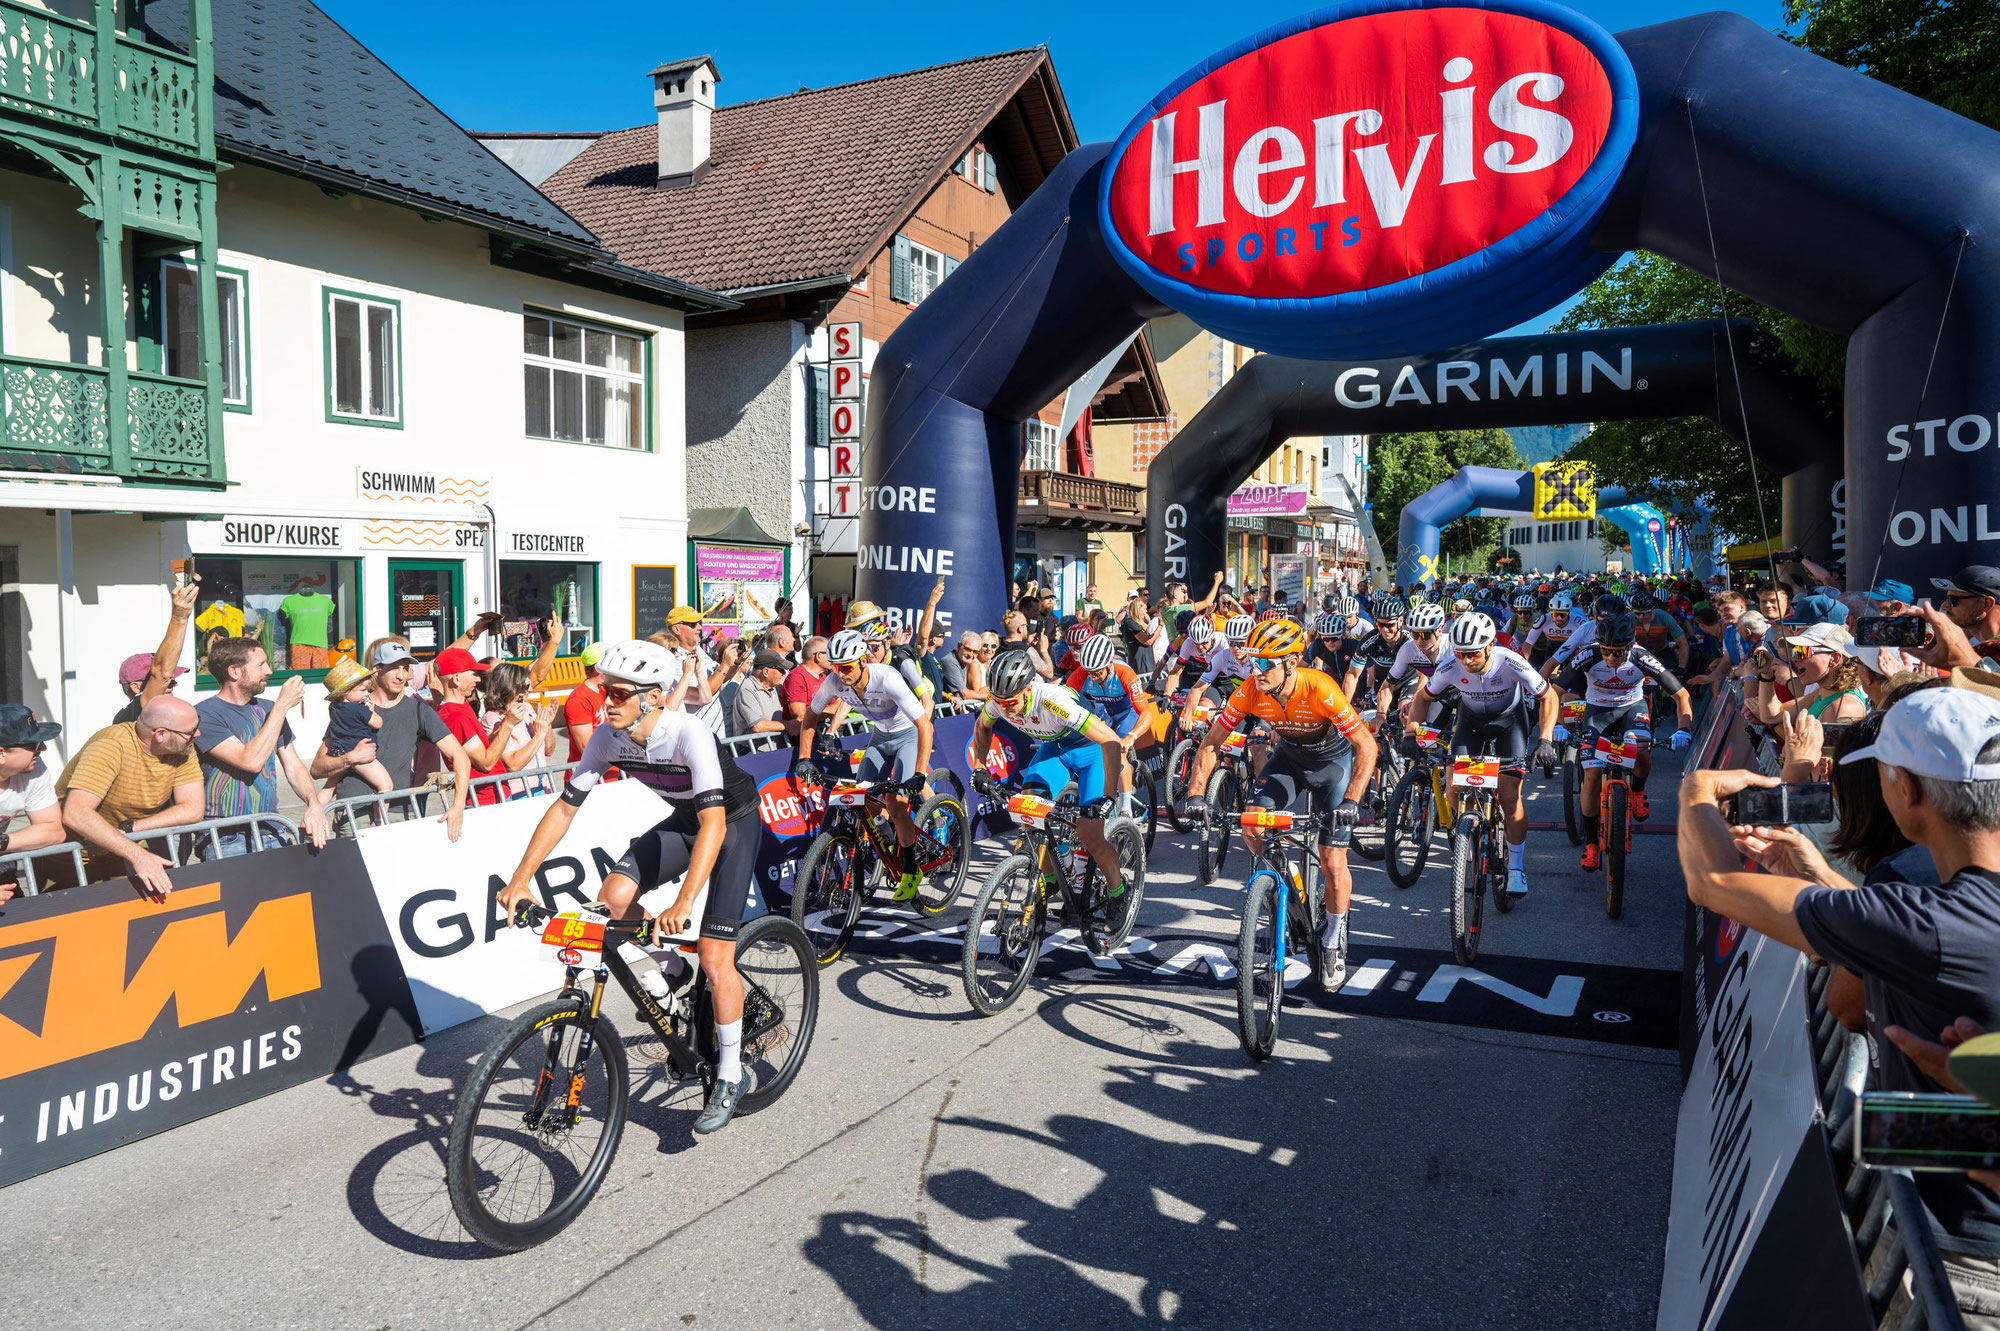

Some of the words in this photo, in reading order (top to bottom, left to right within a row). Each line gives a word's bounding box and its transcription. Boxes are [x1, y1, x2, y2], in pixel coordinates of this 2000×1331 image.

[1147, 57, 1574, 237] Hervis
[1177, 216, 1361, 272] SPORTS
[1334, 347, 1632, 409] GARMIN
[834, 326, 853, 514] SPORT
[1886, 412, 2000, 462] STO
[361, 471, 436, 494] SCHWIMM
[860, 485, 936, 514] STORE
[1240, 485, 1288, 504] ZOPF
[224, 521, 341, 546] SHOP/KURSE
[511, 533, 584, 553] TESTCENTER
[1164, 503, 1188, 587] GAR
[703, 560, 726, 568] BOOTEN
[726, 561, 739, 569] UND
[739, 562, 777, 570] WASSERSPORT
[858, 544, 954, 576] ONLINE
[1639, 654, 1666, 673] KTM
[1060, 709, 1070, 719] 100
[759, 787, 826, 824] Hervis
[978, 801, 998, 815] GET
[1021, 799, 1038, 810] B8
[1256, 813, 1275, 827] B3
[767, 858, 797, 881] GET
[562, 919, 587, 938] B5
[586, 914, 602, 922] AUT
[544, 933, 561, 943] Elias
[534, 1010, 578, 1030] MAXXIS
[36, 1023, 302, 1143] INDUSTRIES
